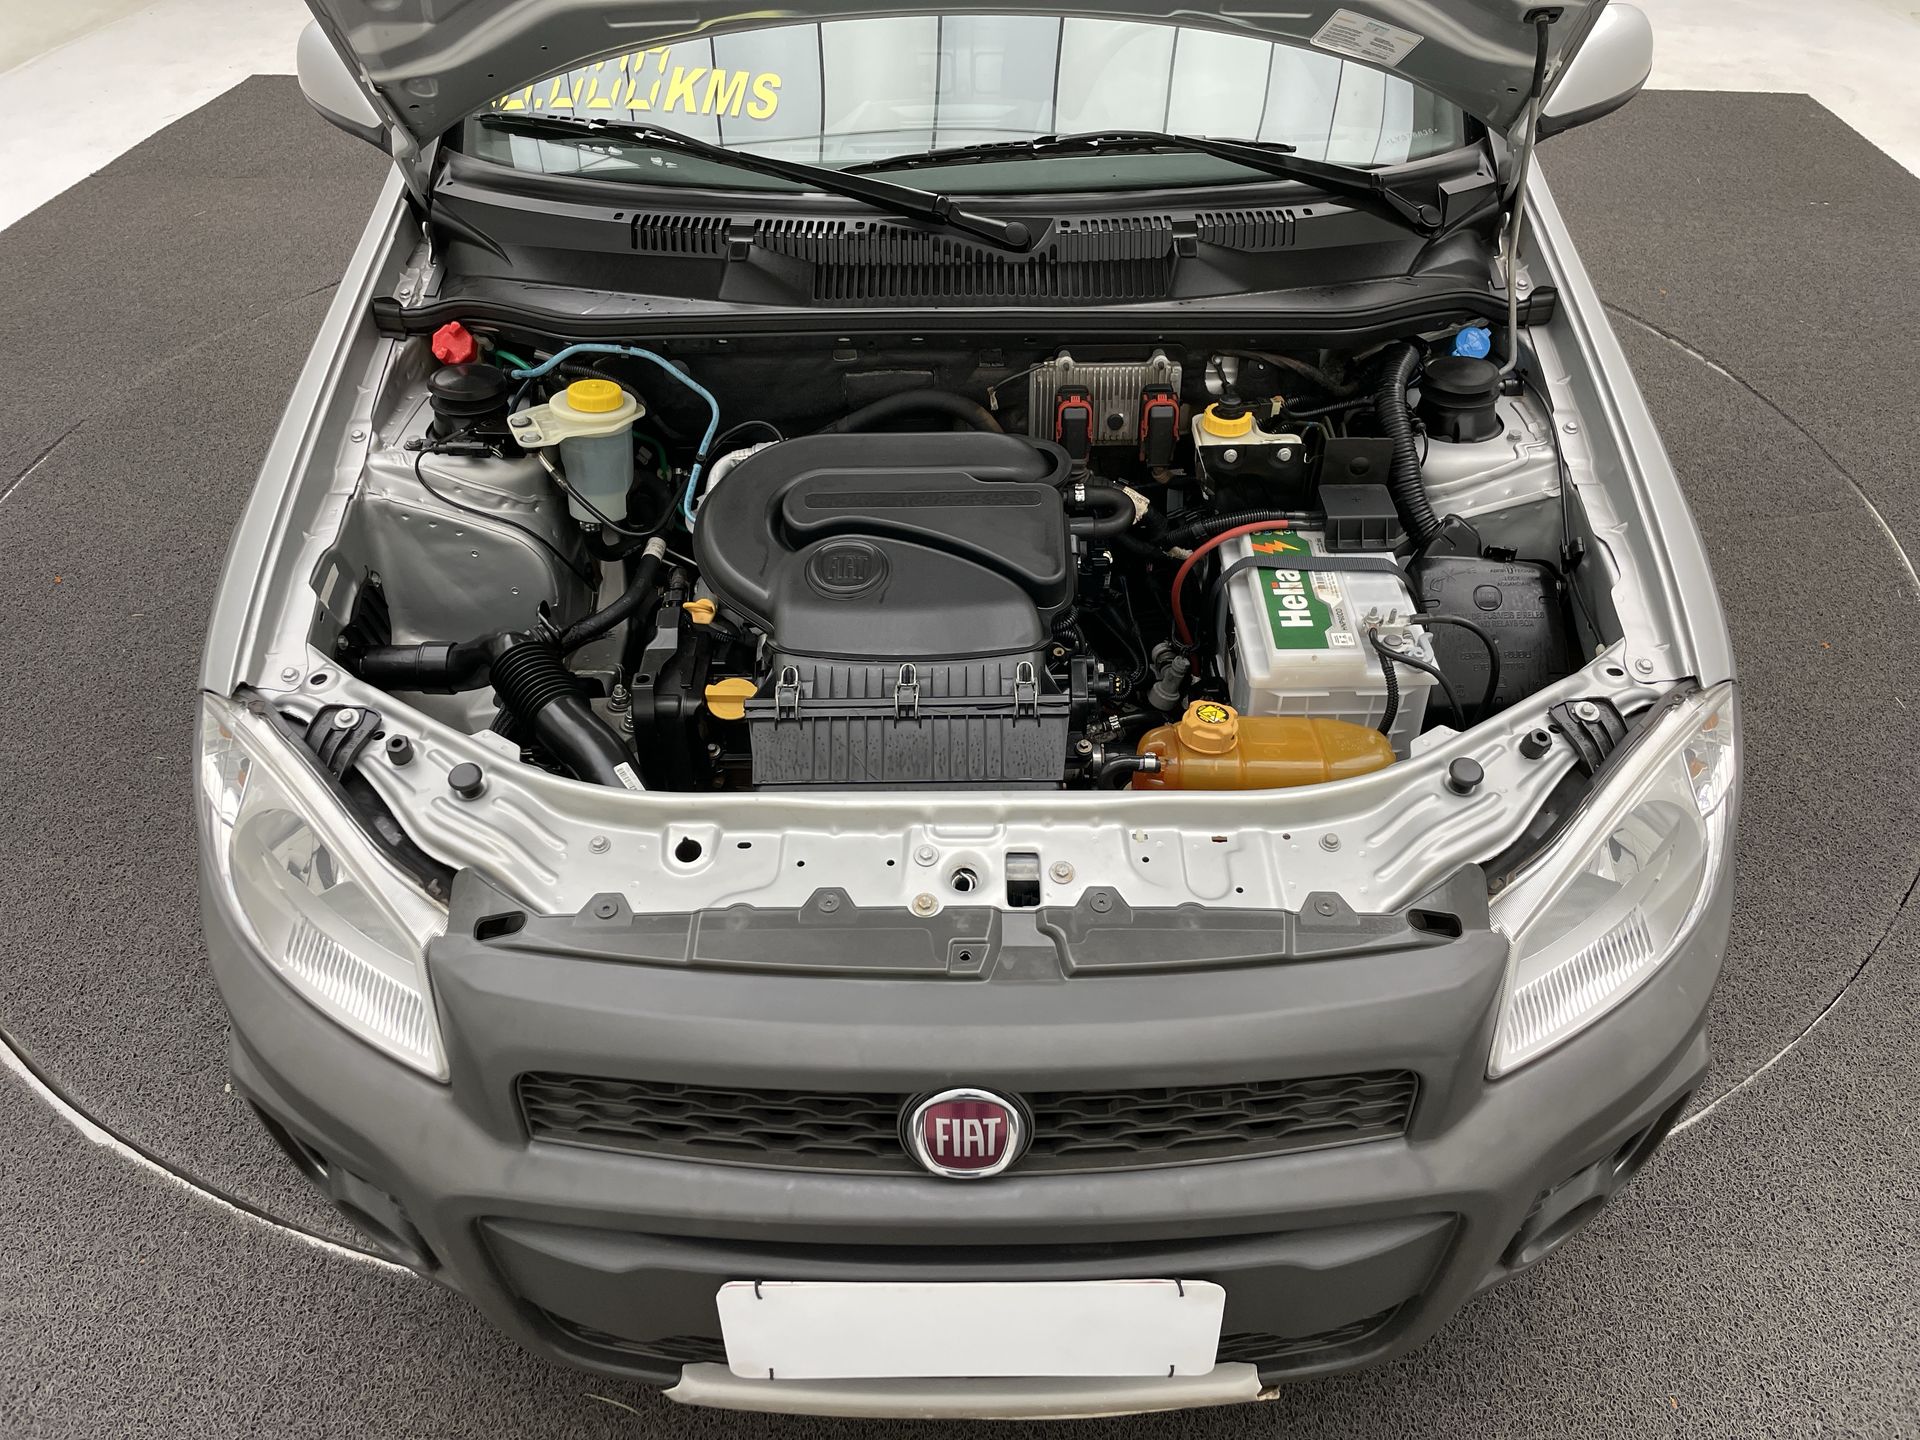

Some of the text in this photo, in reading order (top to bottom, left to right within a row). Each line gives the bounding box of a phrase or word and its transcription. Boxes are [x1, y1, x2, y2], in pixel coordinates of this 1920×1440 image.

[827, 556, 869, 580] FIAT
[1271, 569, 1314, 628] Helia
[935, 1117, 1001, 1157] FIAT
